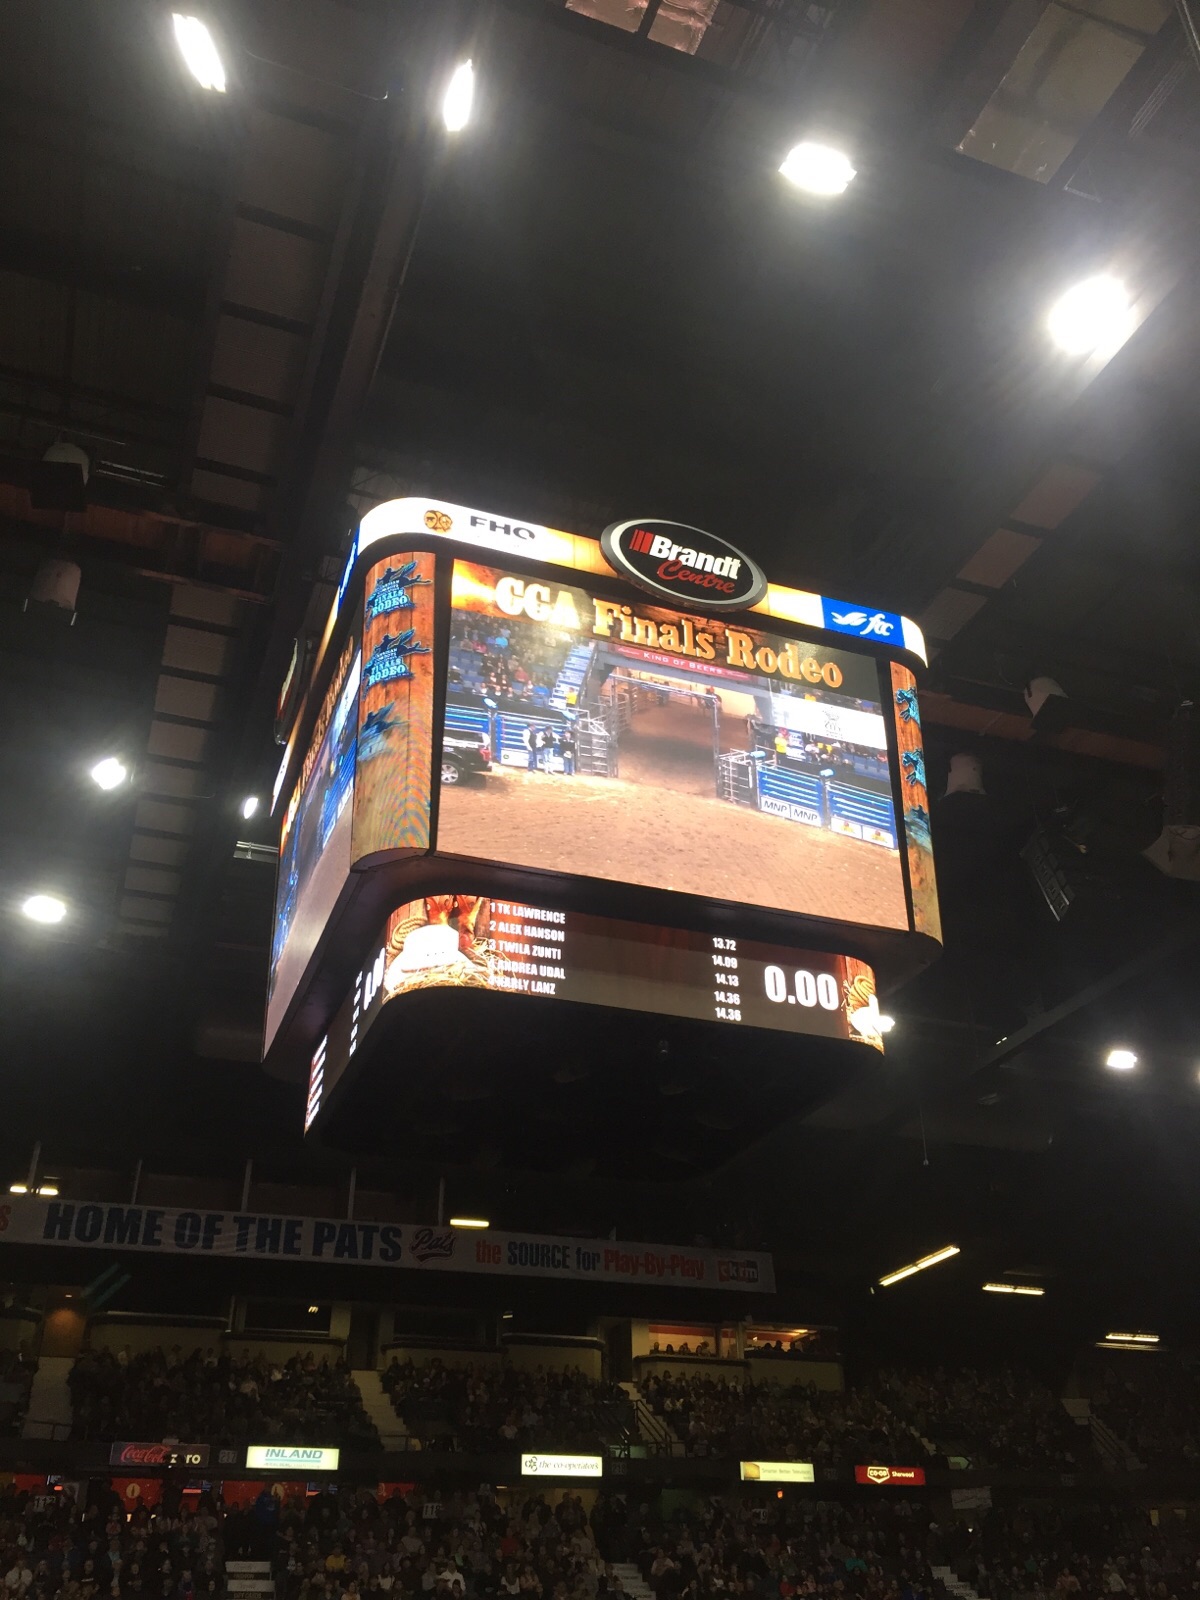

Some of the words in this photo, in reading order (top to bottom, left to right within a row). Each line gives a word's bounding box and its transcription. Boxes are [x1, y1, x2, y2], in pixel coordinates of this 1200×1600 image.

[649, 534, 741, 580] Brandt
[656, 560, 736, 594] Centre
[372, 596, 408, 617] RODEO
[495, 576, 581, 629] CCA
[593, 598, 716, 660] Finals
[726, 628, 843, 688] Rodeo
[368, 665, 406, 686] RODEO
[763, 800, 788, 814] MNP
[793, 808, 818, 821] MNP
[490, 902, 496, 913] 1
[497, 903, 511, 915] TK
[512, 905, 566, 924] LAWRENCE
[489, 920, 496, 931] 2
[497, 921, 522, 935] ALEX
[523, 925, 565, 942] HANSON
[489, 938, 496, 950] 3
[497, 940, 531, 956] TWILA
[531, 945, 561, 960] ZUNTI
[712, 937, 737, 951] 13.72
[497, 960, 538, 976] ANDREA
[539, 965, 566, 979] UDAL
[715, 973, 739, 987] 14.13
[531, 980, 556, 995] LANZ
[714, 991, 741, 1005] 14.36
[764, 965, 839, 1011] 0.00
[43, 1203, 165, 1246] HOME
[174, 1211, 225, 1251] OF
[233, 1215, 303, 1256] THE
[312, 1221, 403, 1262] PATS
[411, 1228, 456, 1255] Pats
[475, 1239, 501, 1264] the
[507, 1240, 571, 1270] SOURCE
[575, 1246, 600, 1271] for
[604, 1248, 705, 1280] Play-By-Play
[170, 1453, 201, 1464] zro
[265, 1448, 323, 1459] INLAND
